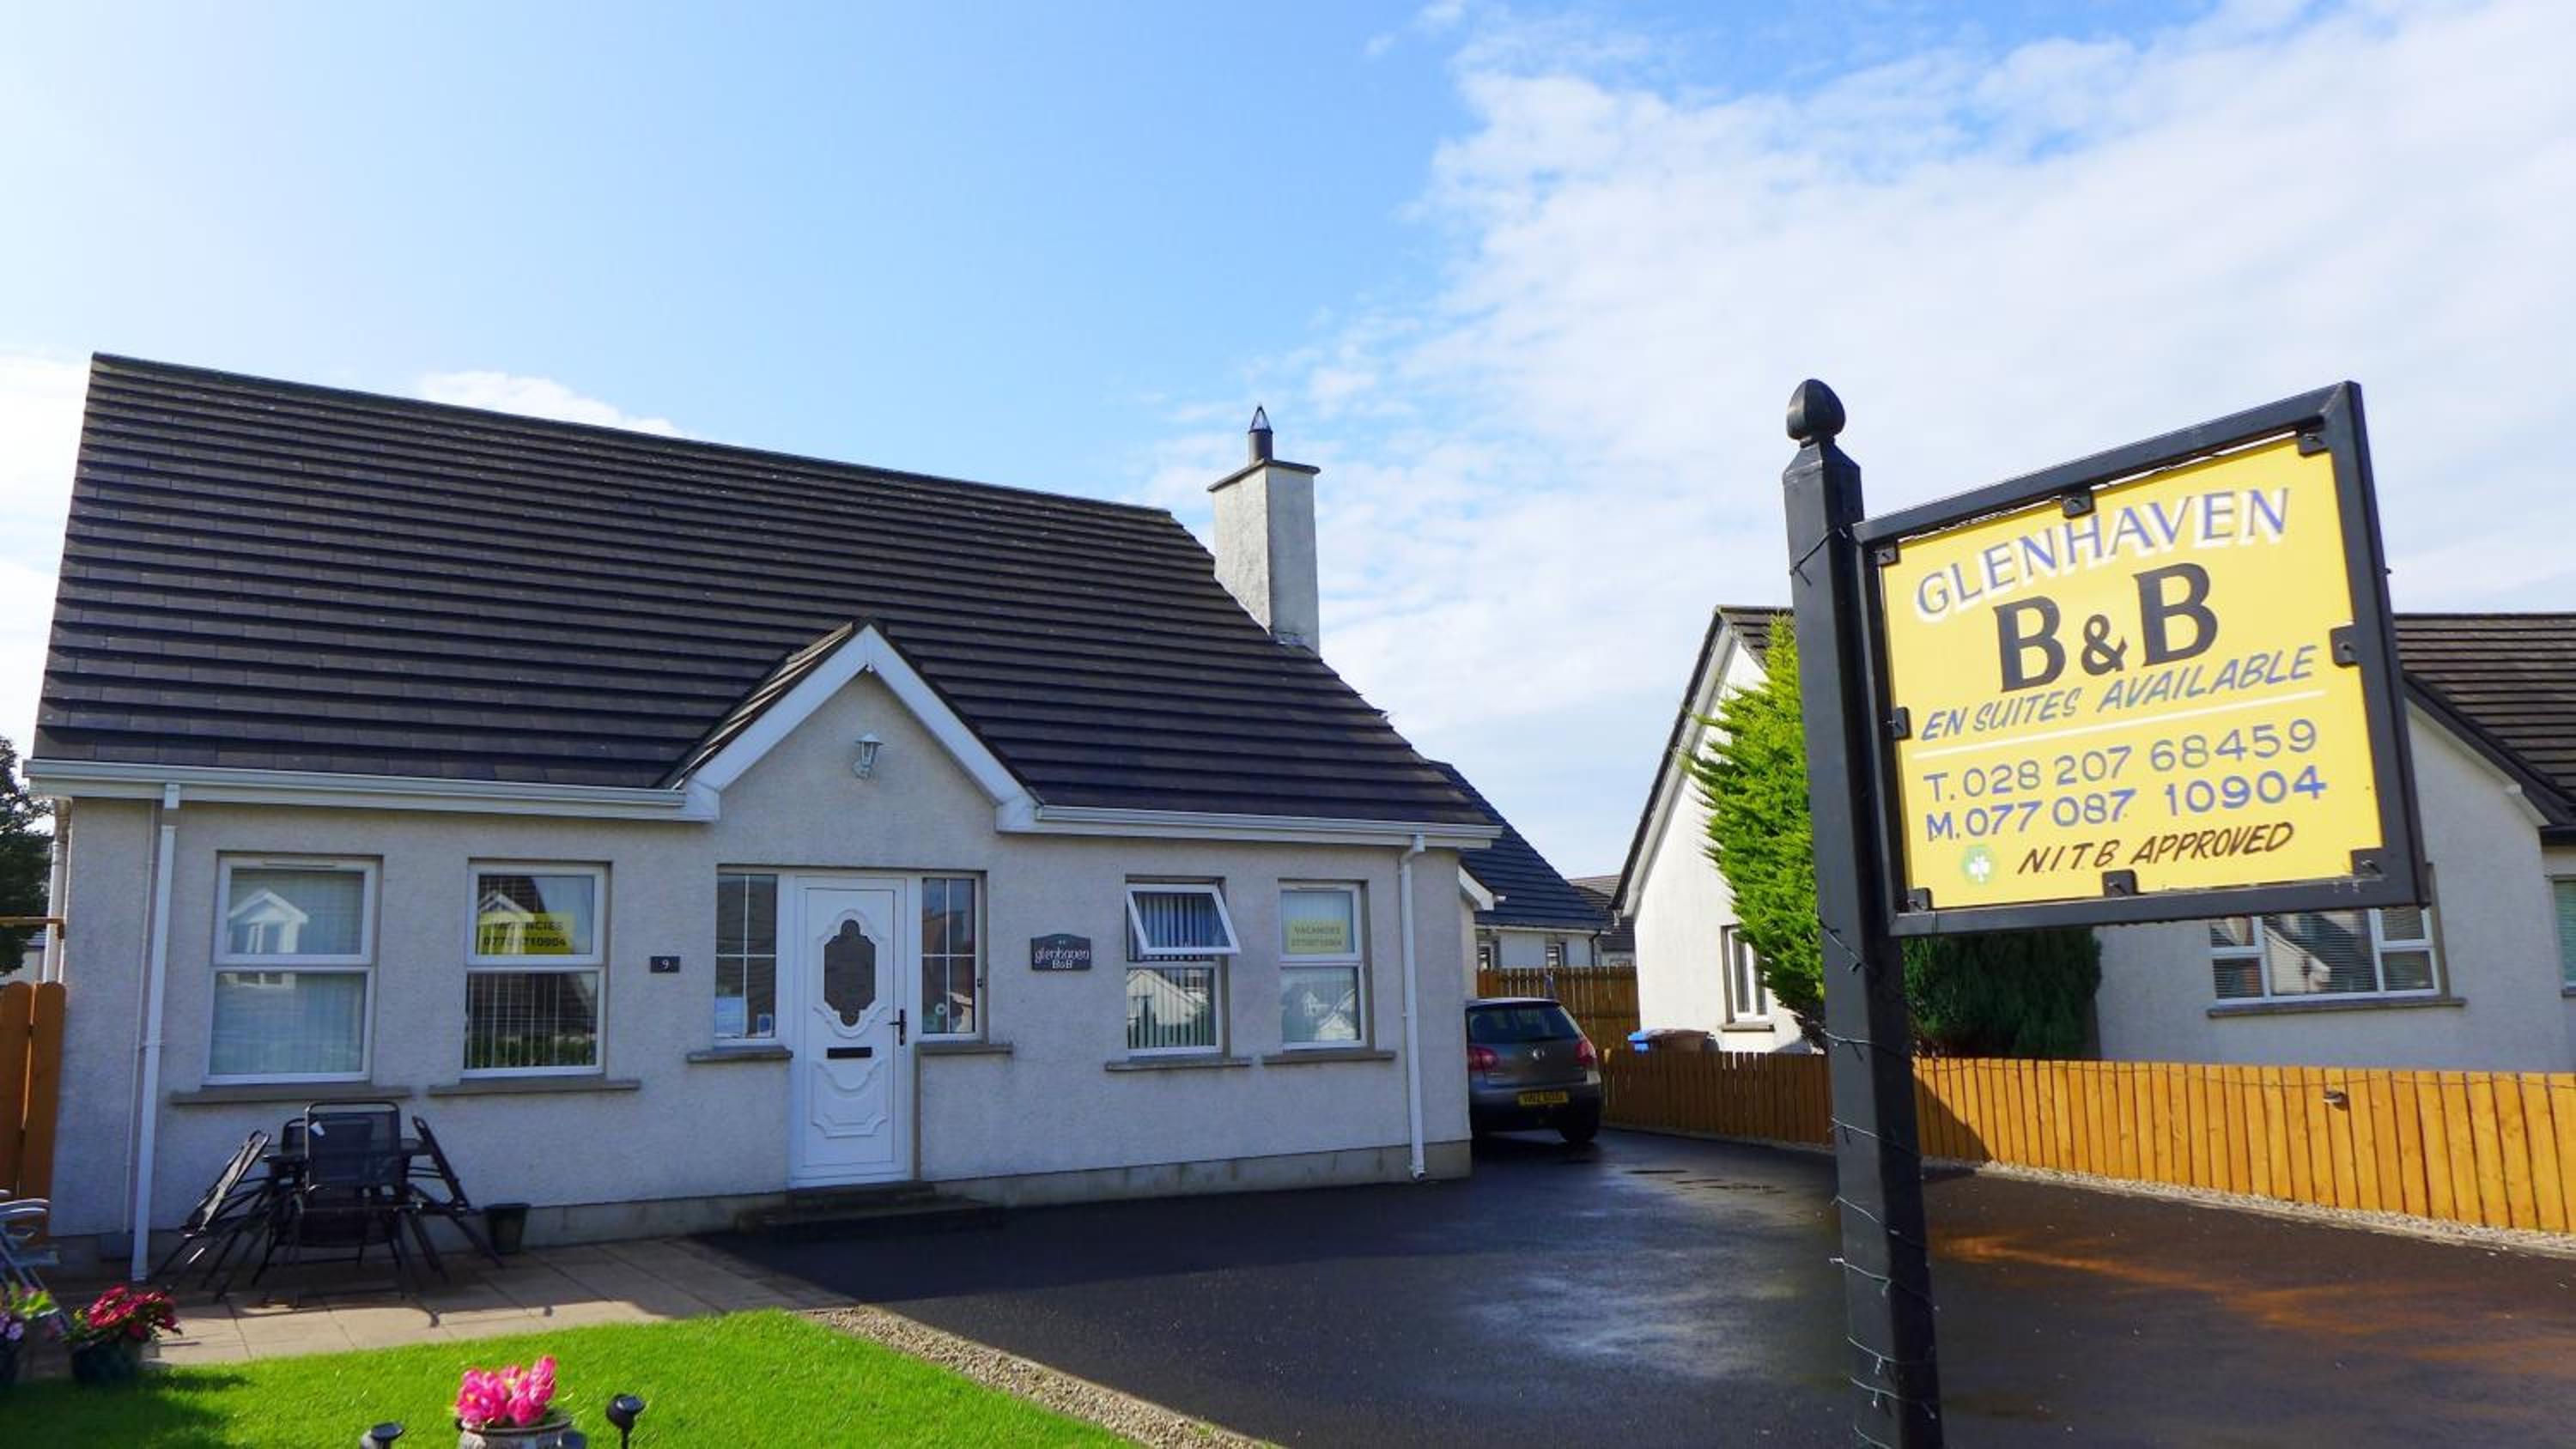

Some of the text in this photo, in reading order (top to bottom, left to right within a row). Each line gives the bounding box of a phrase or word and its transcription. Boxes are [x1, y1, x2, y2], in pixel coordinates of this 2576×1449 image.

[1915, 487, 2288, 620] GLENHAVEN
[1991, 562, 2219, 693] B&B
[1921, 645, 2318, 742] EN SUITES AVAILABLE
[2053, 745, 2132, 787] 207
[2149, 718, 2317, 773] 68459
[2051, 788, 2136, 828] 087
[2164, 764, 2328, 816] 10904
[2129, 821, 2294, 865] APPROVED
[662, 959, 669, 969] 9
